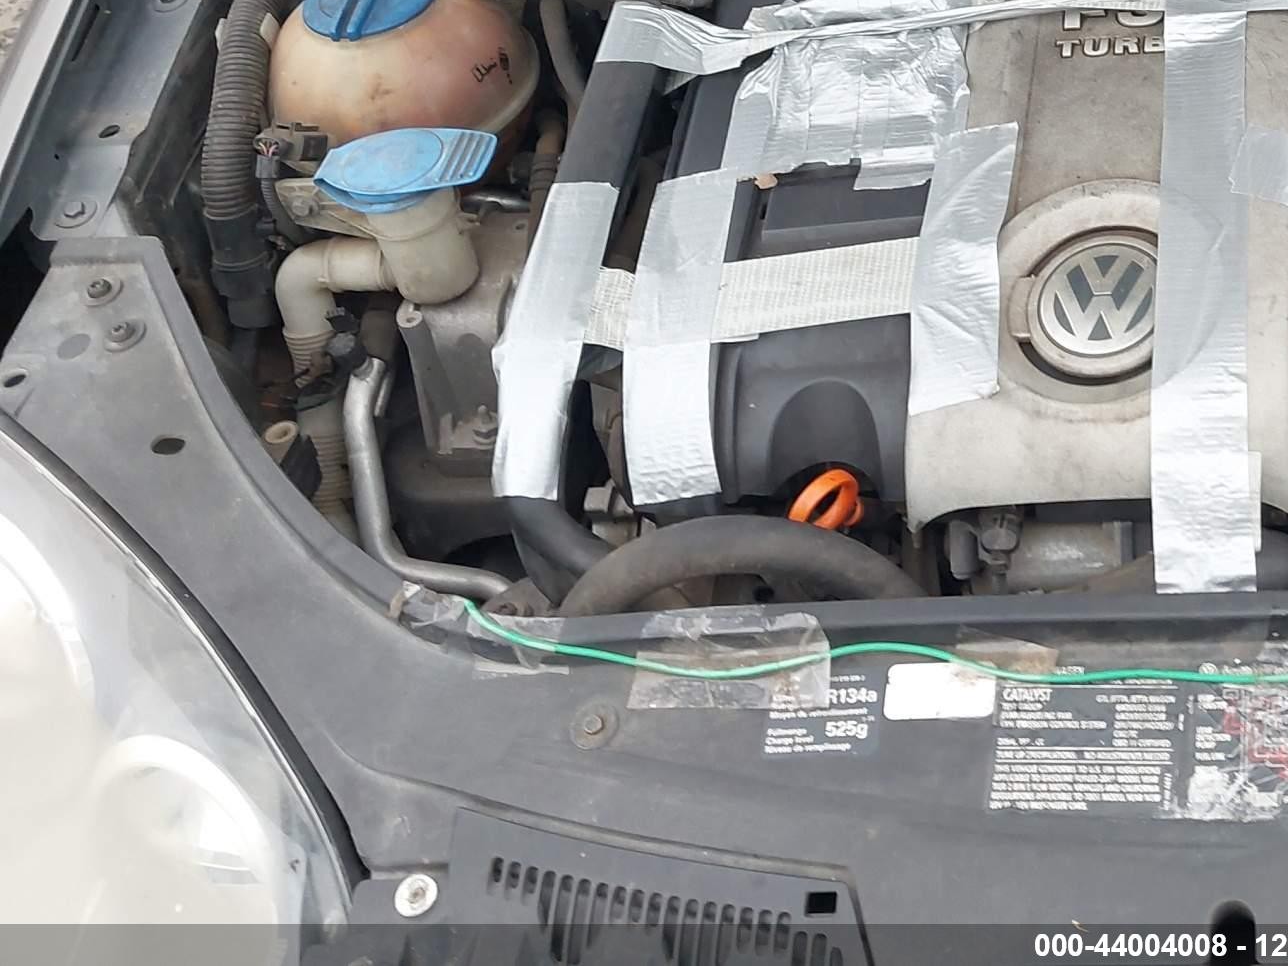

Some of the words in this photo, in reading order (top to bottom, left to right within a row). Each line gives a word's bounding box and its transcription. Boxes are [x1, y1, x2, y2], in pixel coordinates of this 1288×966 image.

[1055, 35, 1165, 58] TURB
[827, 687, 878, 705] R134a
[1002, 688, 1053, 702] CATALYST
[824, 720, 868, 739] 525g
